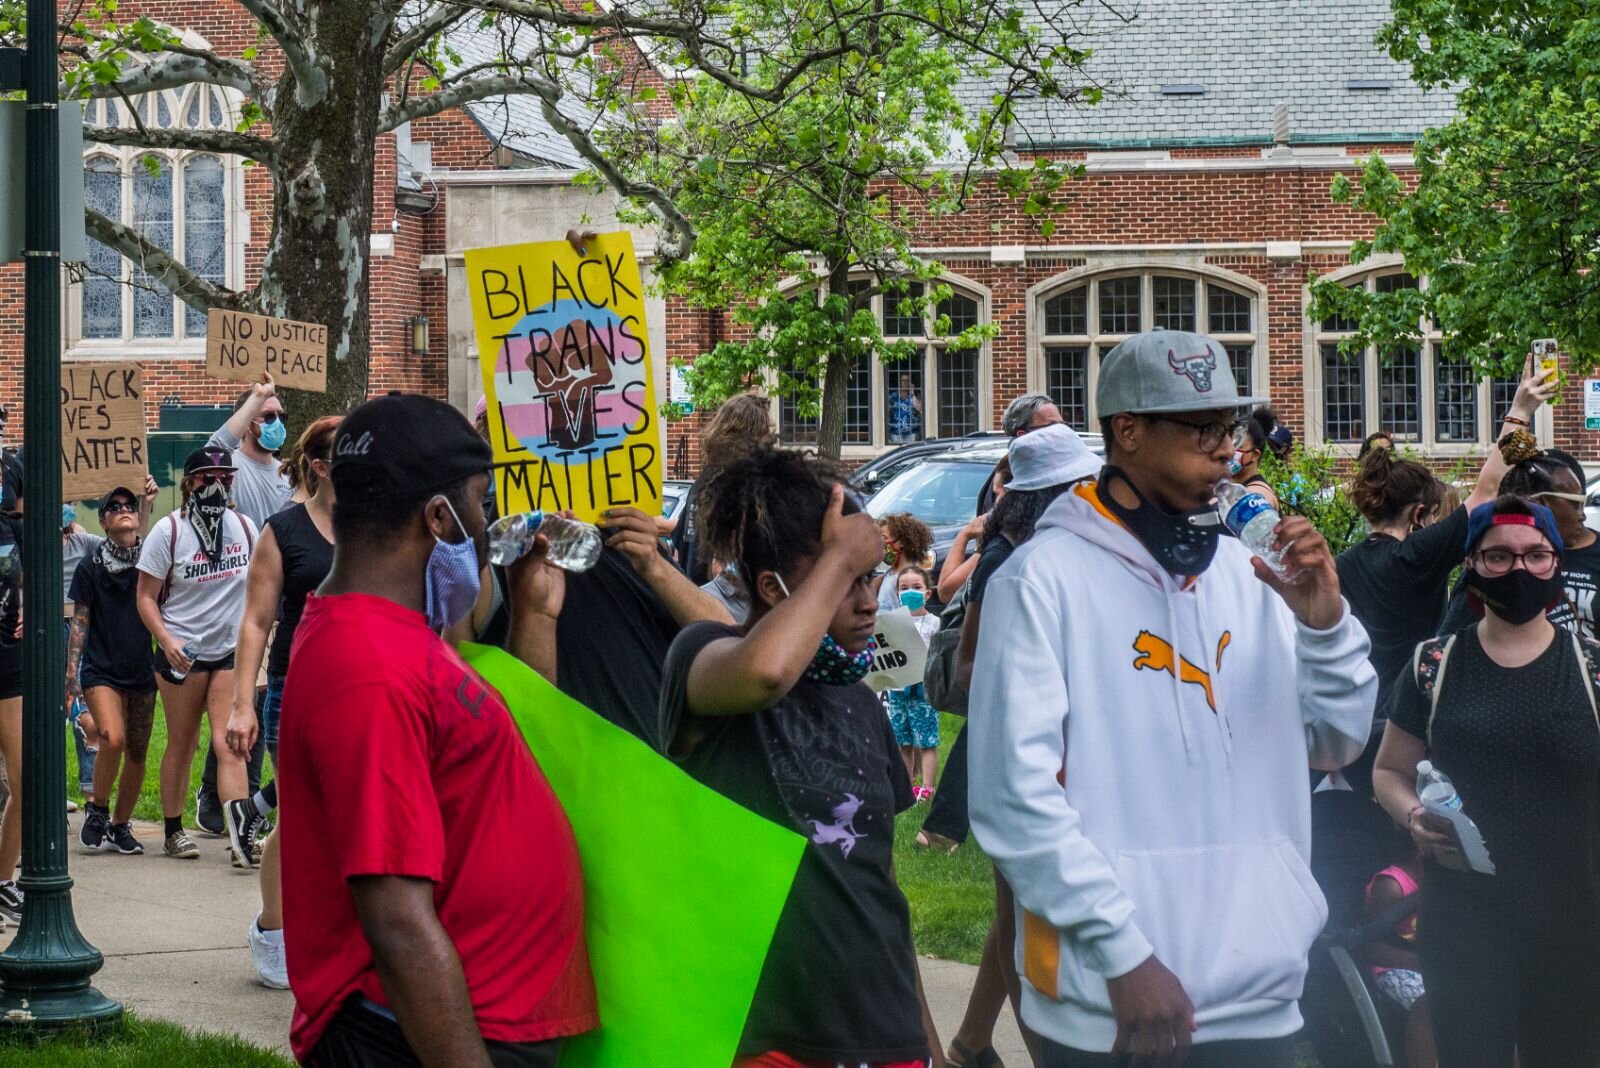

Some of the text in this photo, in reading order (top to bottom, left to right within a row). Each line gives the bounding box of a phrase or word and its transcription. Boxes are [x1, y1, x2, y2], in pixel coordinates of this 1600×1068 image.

[481, 252, 638, 320] BLACK
[222, 313, 326, 345] NO JUSTICE
[220, 343, 323, 375] NO PEACE
[491, 315, 646, 385] TRANS
[64, 404, 112, 433] VES
[498, 380, 650, 453] LIVES
[336, 430, 375, 456] Cali
[500, 443, 657, 516] MATTER
[183, 554, 248, 579] SHOWGIRLS
[1569, 571, 1592, 580] HOPE
[874, 633, 889, 649] E
